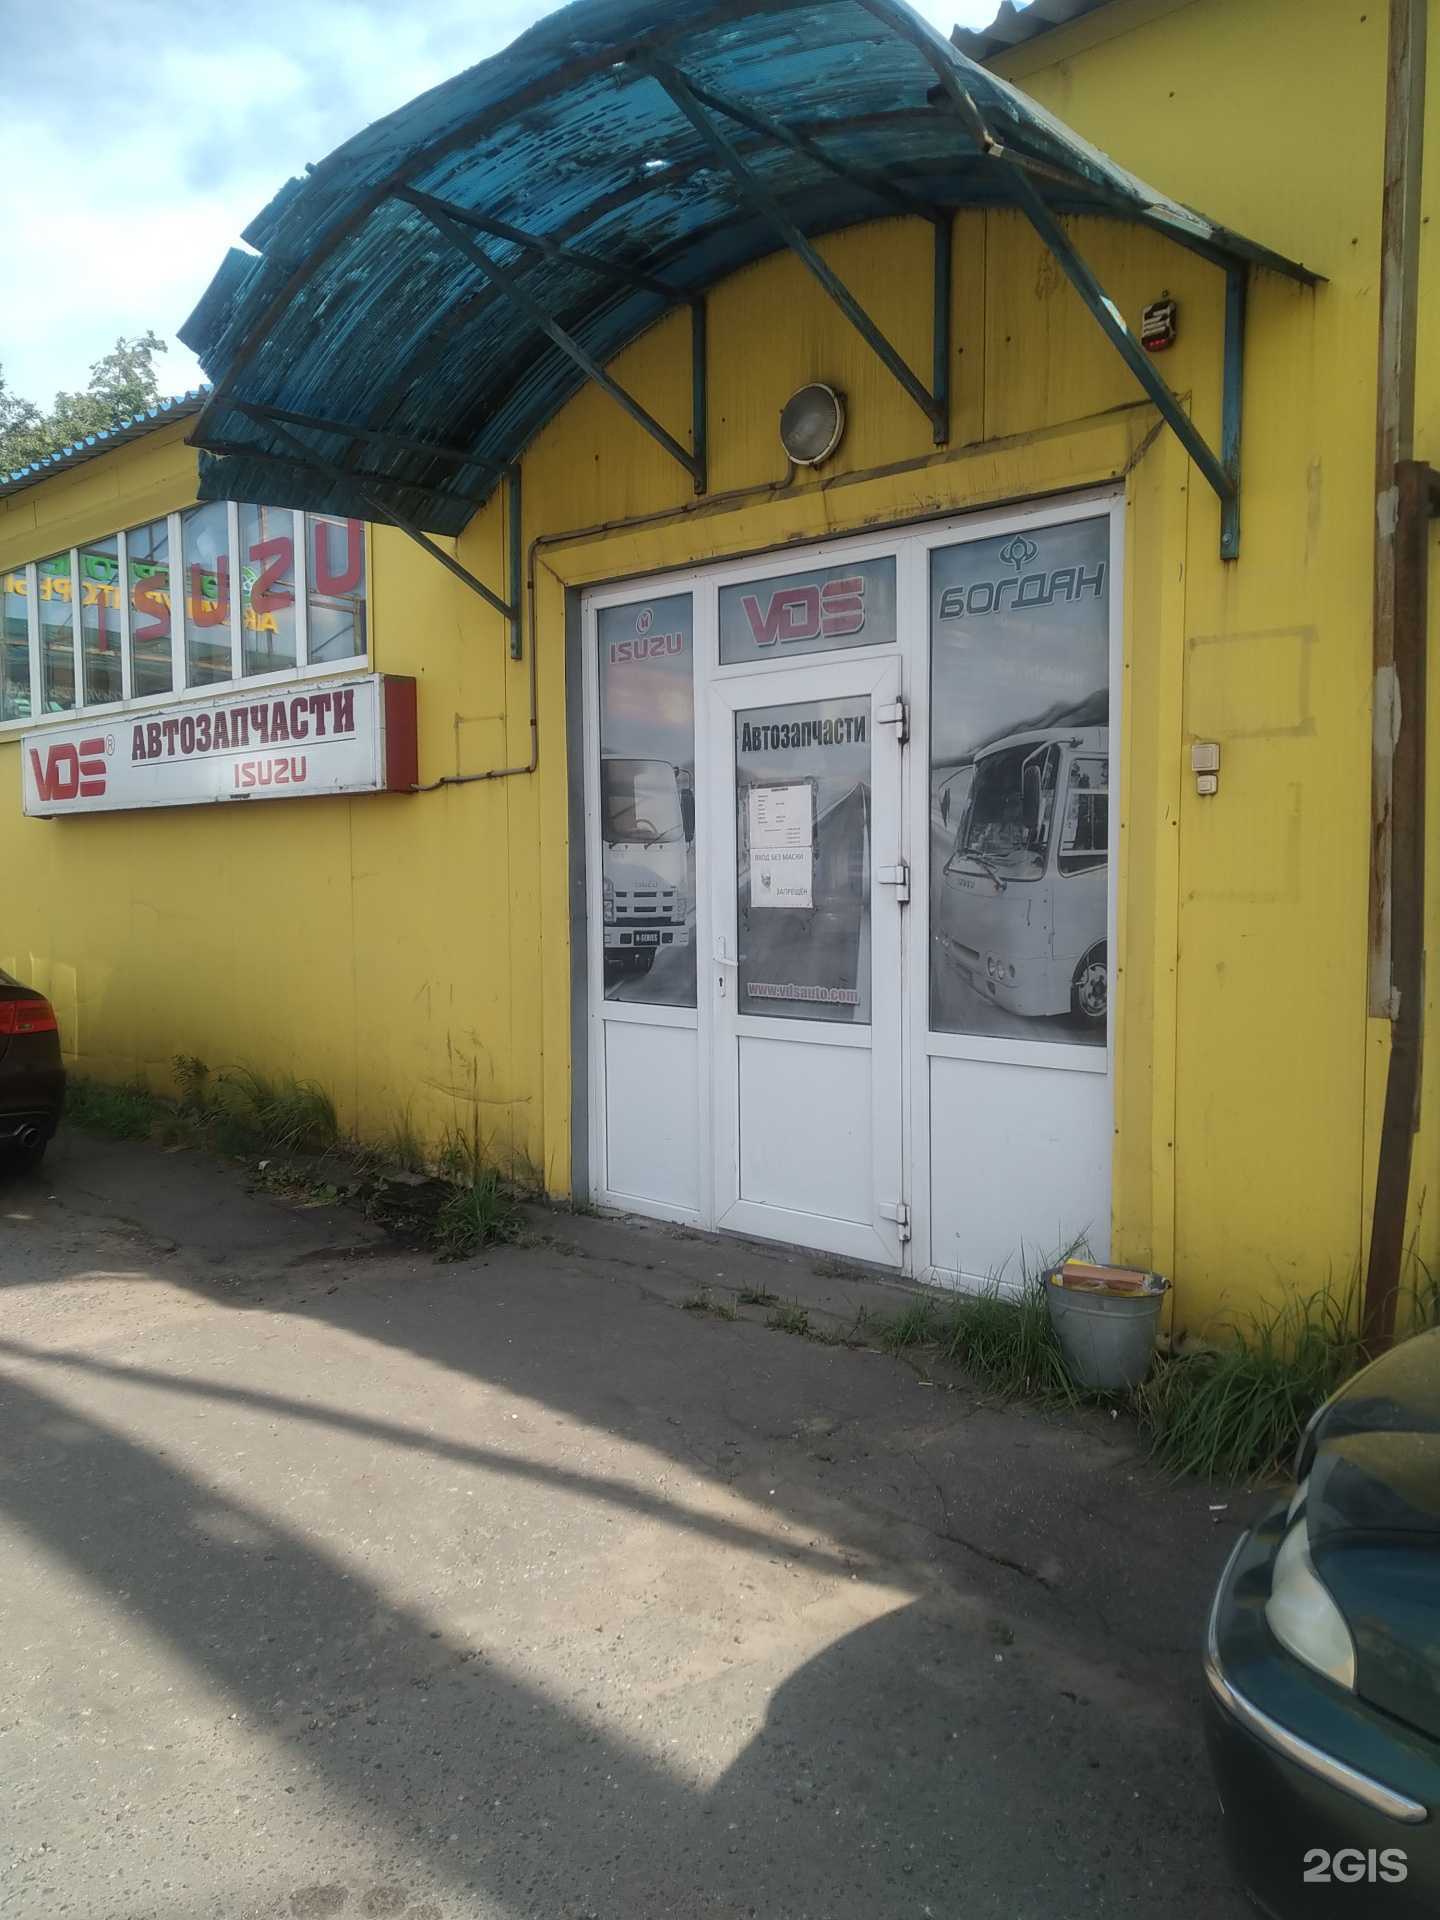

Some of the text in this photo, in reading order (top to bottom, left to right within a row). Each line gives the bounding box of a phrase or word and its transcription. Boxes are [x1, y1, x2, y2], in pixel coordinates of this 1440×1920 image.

[97, 519, 362, 651] ISUZU
[939, 562, 1106, 621] БОГДАН
[740, 576, 865, 647] VDS
[609, 632, 684, 664] ISUZU
[131, 689, 356, 760] АВТОЗАПЧАСТИ
[742, 716, 866, 752] Автозапчасти
[234, 756, 307, 788] ISUZU
[748, 983, 859, 1004] www.vdsauto.com
